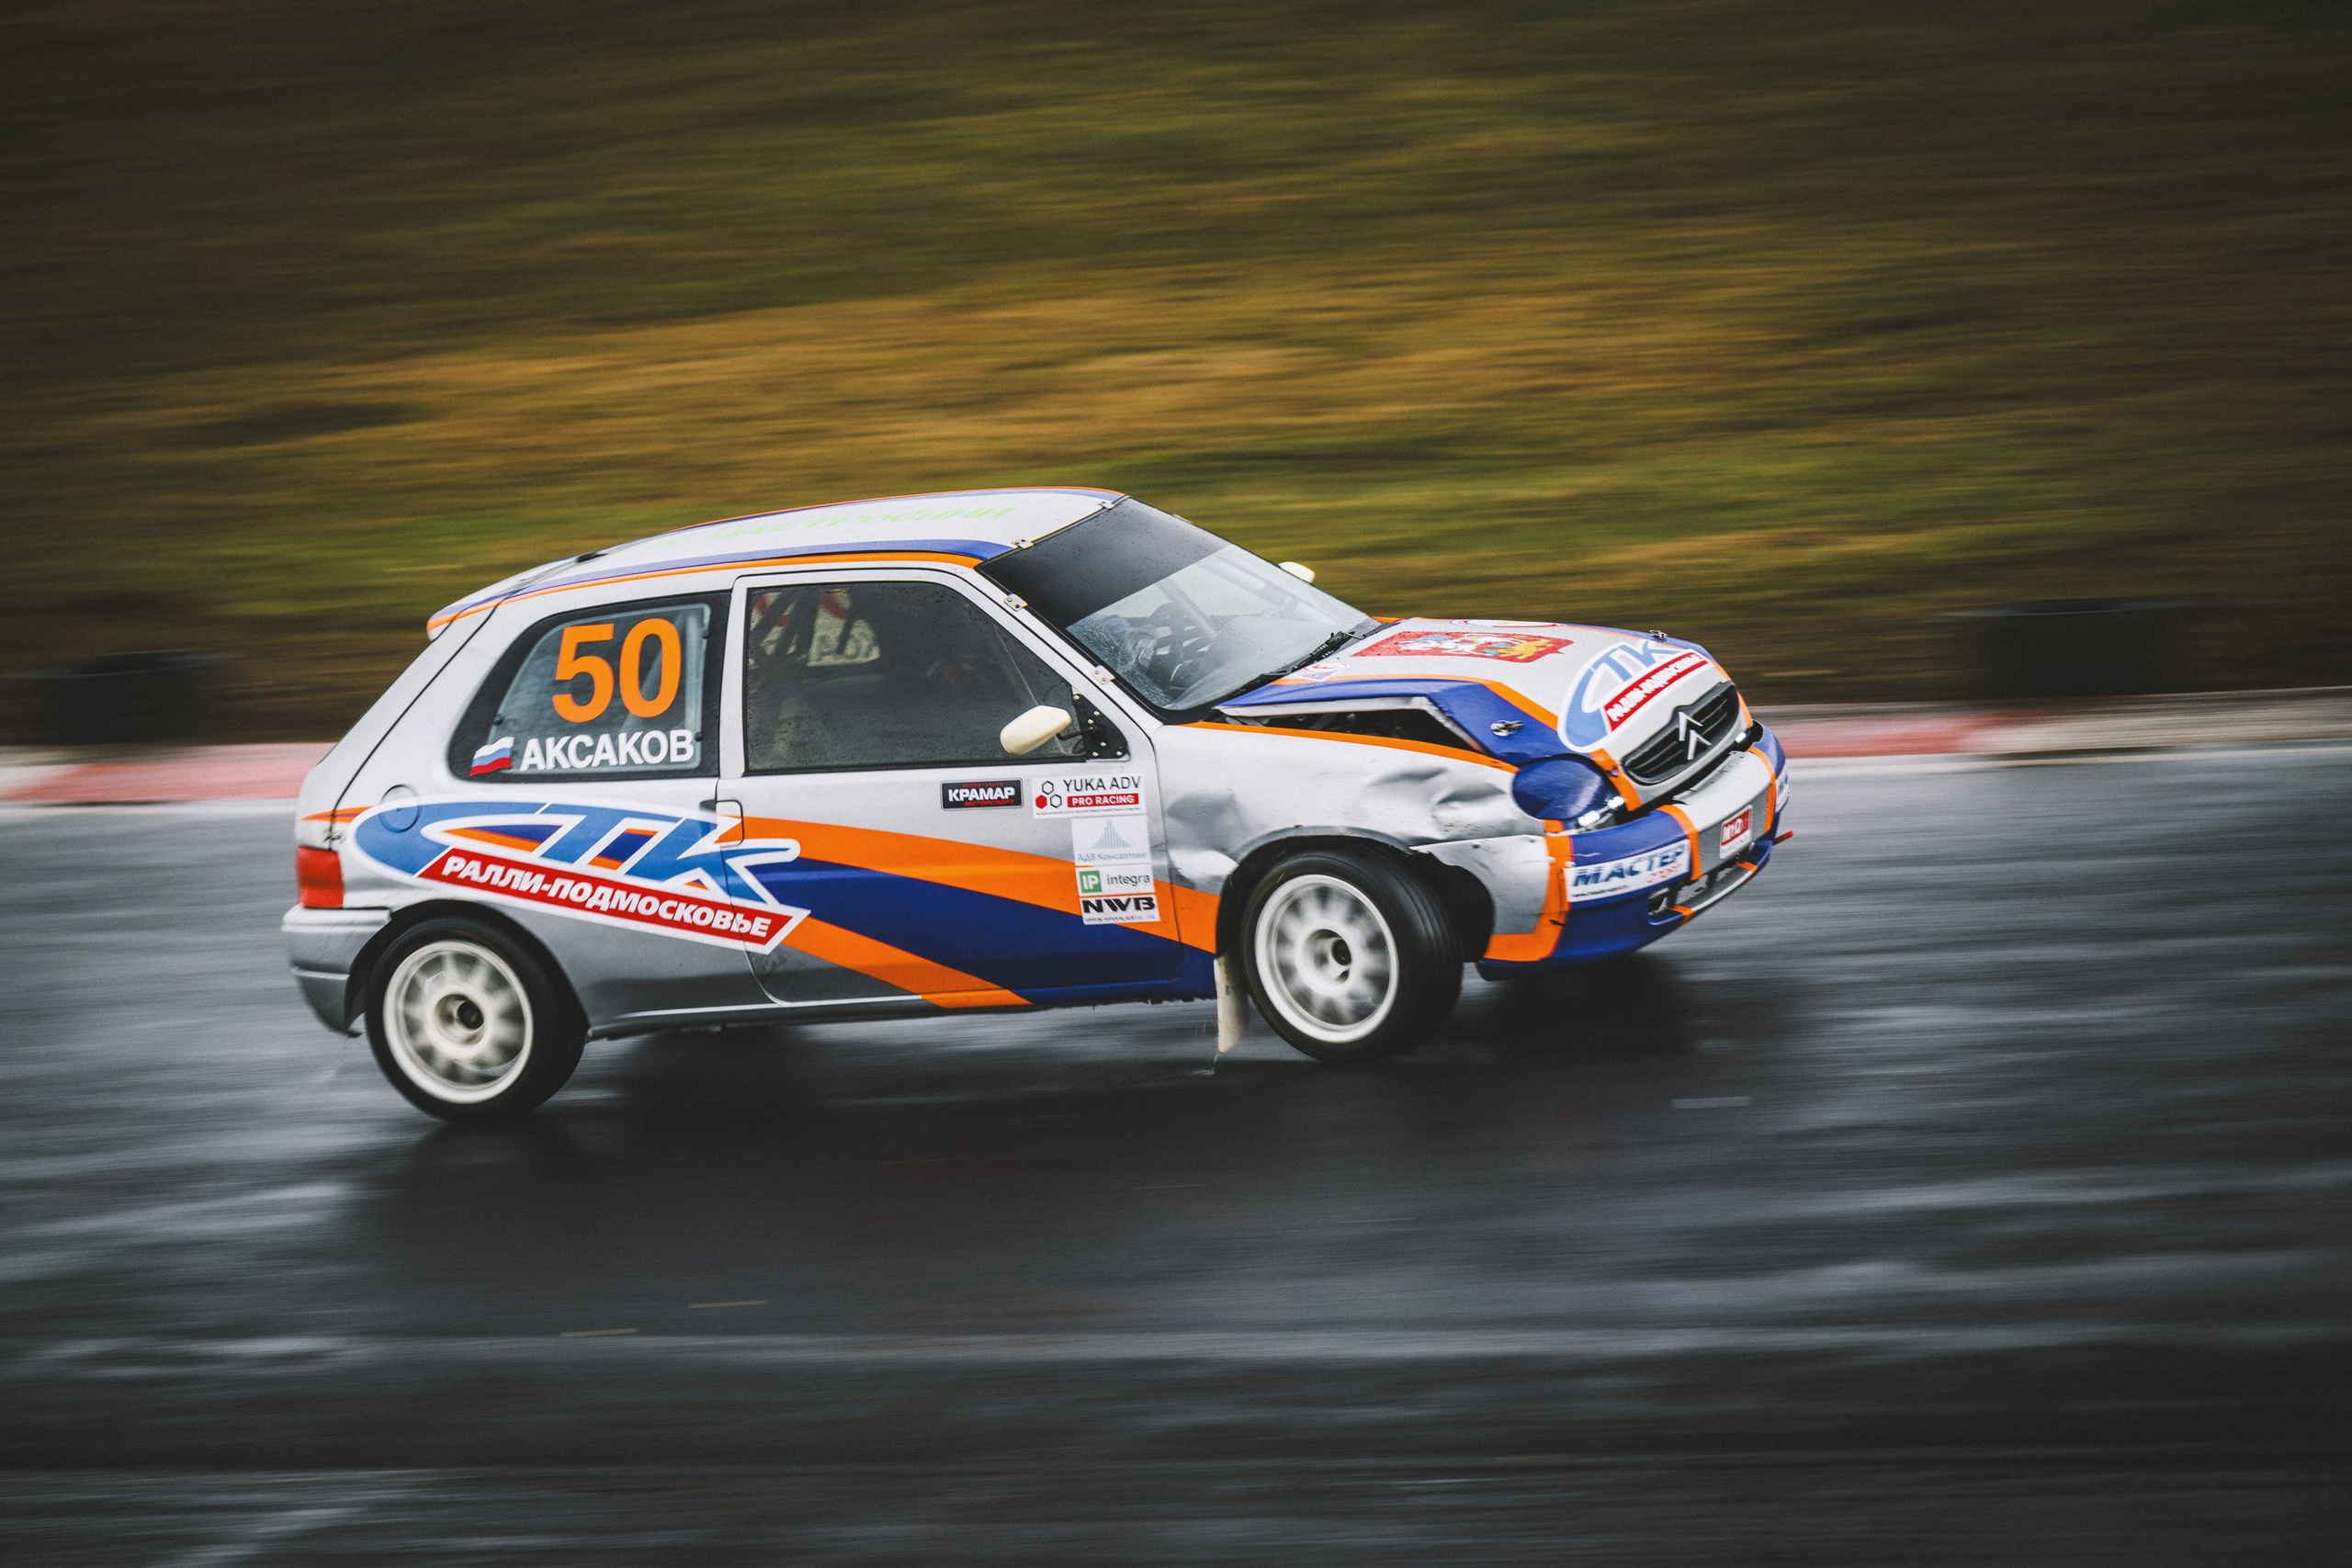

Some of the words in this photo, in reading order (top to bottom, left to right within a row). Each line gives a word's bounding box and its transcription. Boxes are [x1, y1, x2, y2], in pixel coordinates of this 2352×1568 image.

[552, 618, 682, 723] 50
[519, 729, 694, 772] АКСАКОВ
[1063, 778, 1106, 792] YUKA
[1110, 776, 1141, 790] ADV
[948, 787, 1015, 802] КРАМАР
[1071, 796, 1093, 807] PRO
[1095, 795, 1136, 805] RACING
[1082, 874, 1099, 890] IP
[1107, 874, 1150, 886] integra
[442, 856, 771, 937] РАЛЛИ-ПОДМОСКОВЬЕ
[1082, 897, 1155, 913] NWB
